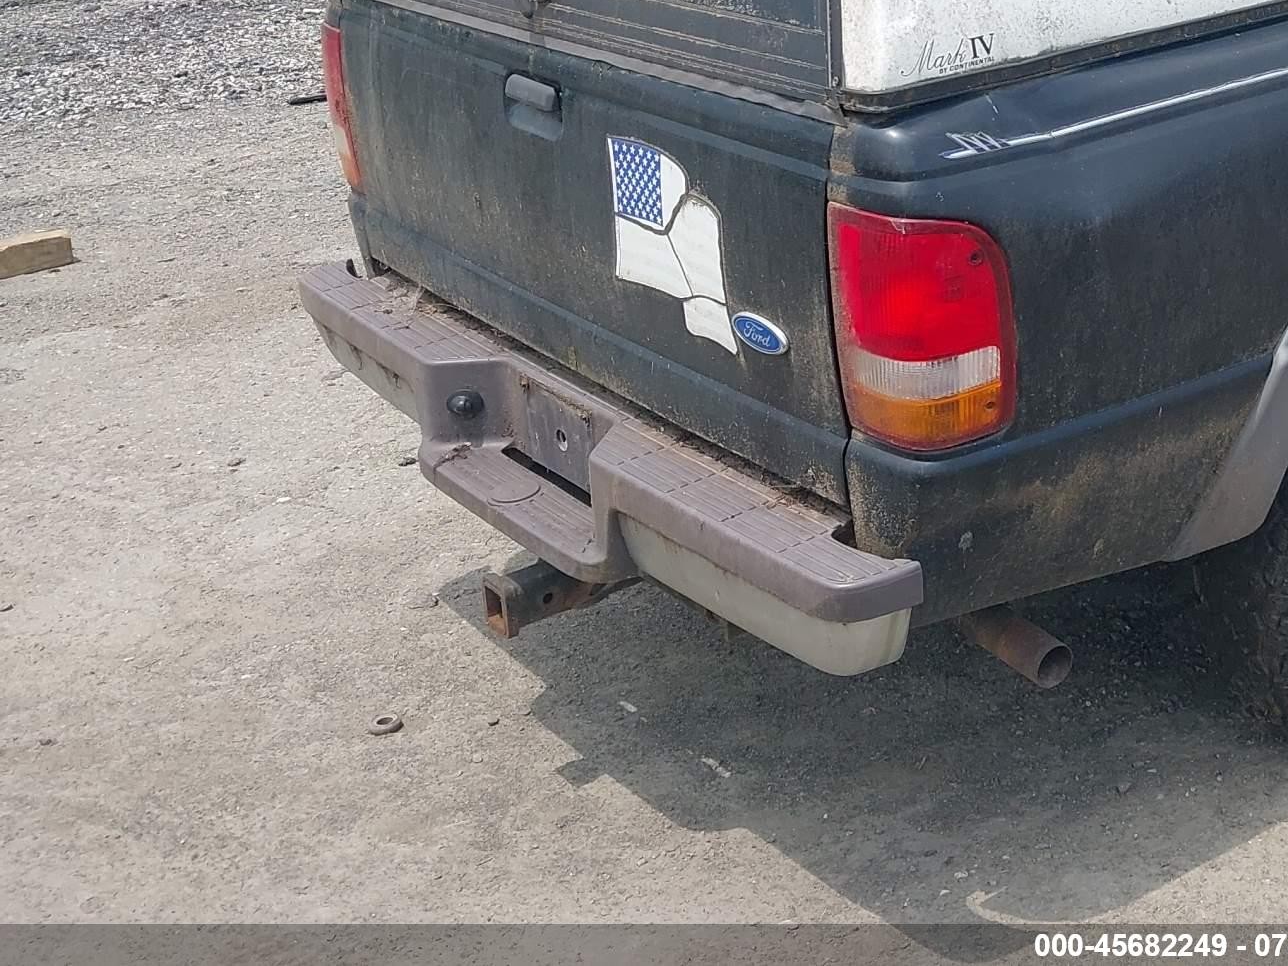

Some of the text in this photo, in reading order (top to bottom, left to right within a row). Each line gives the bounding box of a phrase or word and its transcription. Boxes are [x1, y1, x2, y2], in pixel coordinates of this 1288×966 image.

[900, 32, 995, 77] Mark IV
[949, 55, 995, 72] CONTINENTAL
[743, 320, 771, 347] Ford
